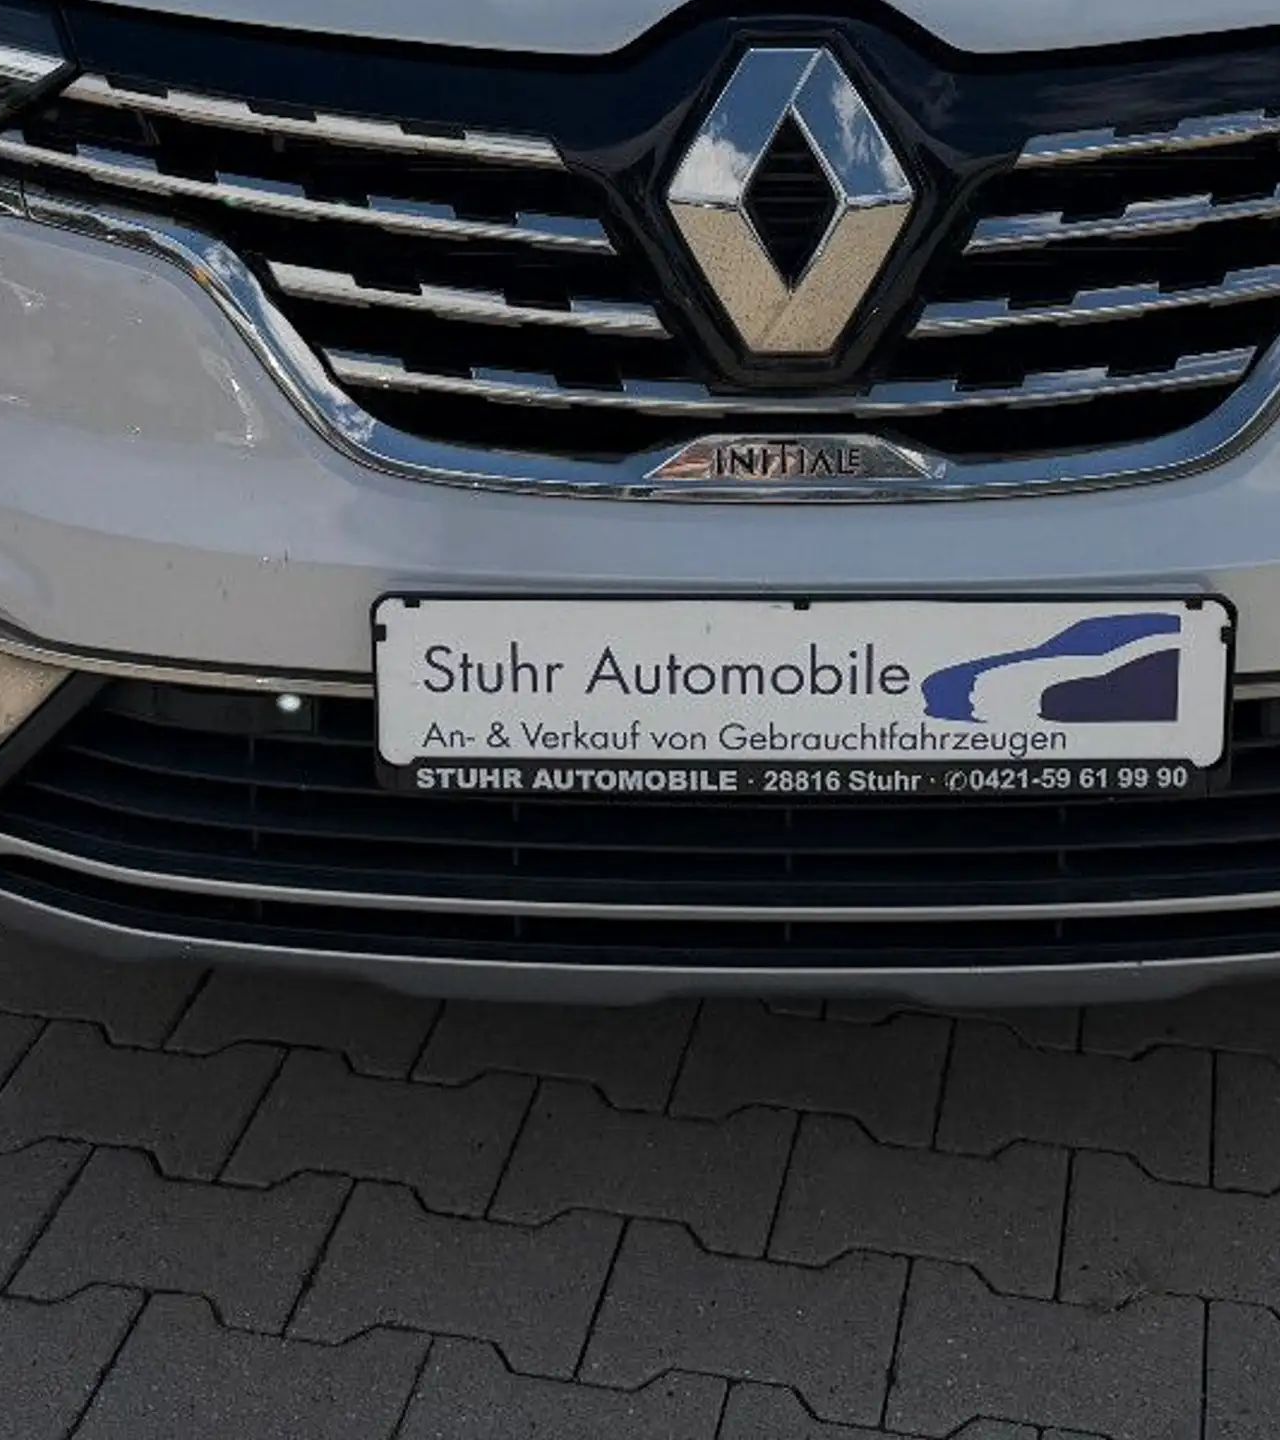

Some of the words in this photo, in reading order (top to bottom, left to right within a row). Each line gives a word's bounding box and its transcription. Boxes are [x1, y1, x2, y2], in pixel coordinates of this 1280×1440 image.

[714, 440, 861, 476] INITIALE
[422, 641, 565, 694] Stuhr
[585, 642, 911, 696] Automobile
[421, 721, 476, 749] An-
[486, 721, 511, 749] &
[521, 718, 642, 751] Verkauf
[650, 731, 707, 751] von
[719, 720, 1067, 759] Gebrauchtfahrzeugen
[416, 767, 524, 790] STUHR
[532, 768, 738, 791] AUTOMOBILE
[763, 770, 840, 792] 28816
[848, 769, 922, 792] Stuhr
[970, 768, 1073, 790] 0421-59
[1079, 767, 1108, 789] 61
[1118, 767, 1152, 789] 99
[1157, 766, 1188, 789] 90
